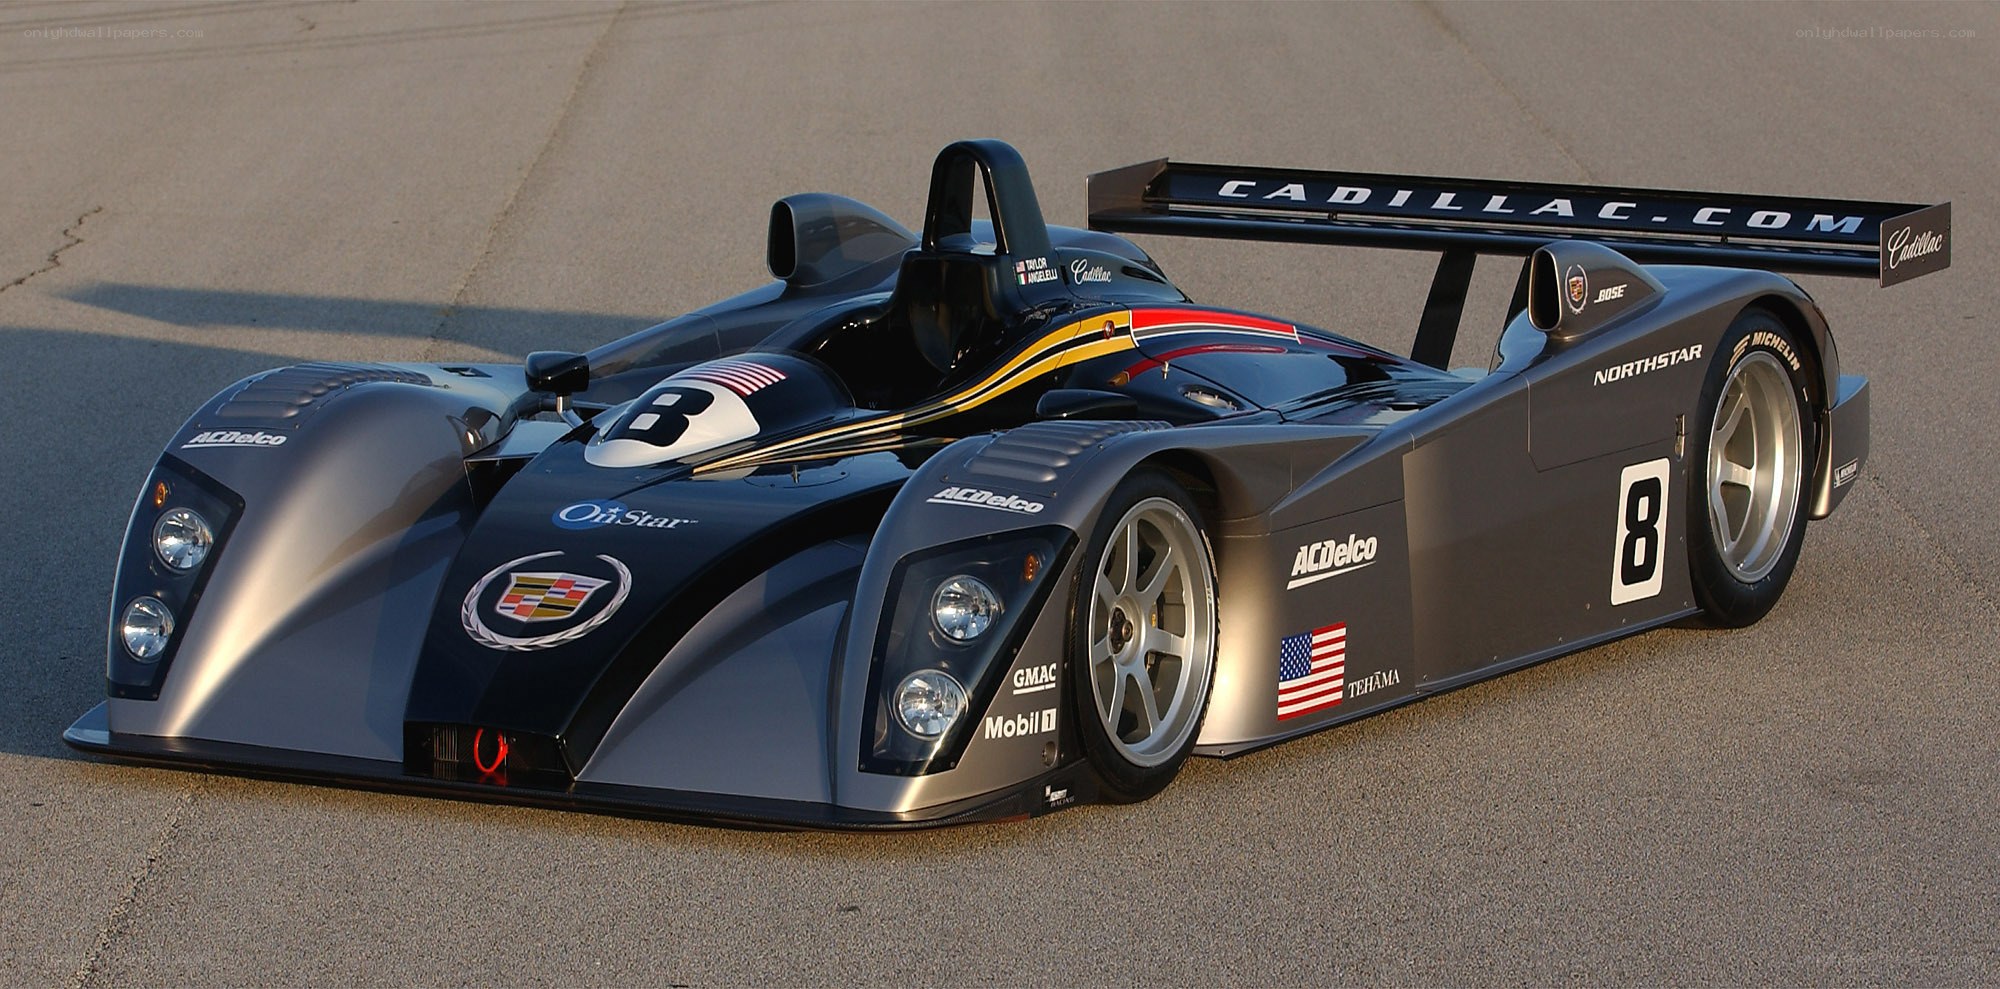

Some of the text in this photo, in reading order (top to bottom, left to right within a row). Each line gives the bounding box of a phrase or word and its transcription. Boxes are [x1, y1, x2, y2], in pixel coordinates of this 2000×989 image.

[1218, 180, 1864, 234] CADILLAC.COM
[1888, 226, 1942, 269] Cadillac
[1025, 257, 1048, 271] TAYLOR
[1028, 269, 1058, 283] ANGELELLI
[1070, 259, 1112, 285] Cadillac
[1594, 284, 1627, 303] BOSE
[1594, 344, 1702, 386] NORTHSTAR
[1752, 331, 1801, 372] MICHELIN
[602, 386, 715, 448] 8
[188, 431, 288, 446] ACDelco
[933, 486, 1045, 513] ACDelco
[559, 503, 689, 529] OnStar
[1621, 476, 1662, 586] 8
[1291, 533, 1378, 577] ACDelco
[1013, 662, 1057, 688] GMAC
[984, 711, 1039, 739] Mobil
